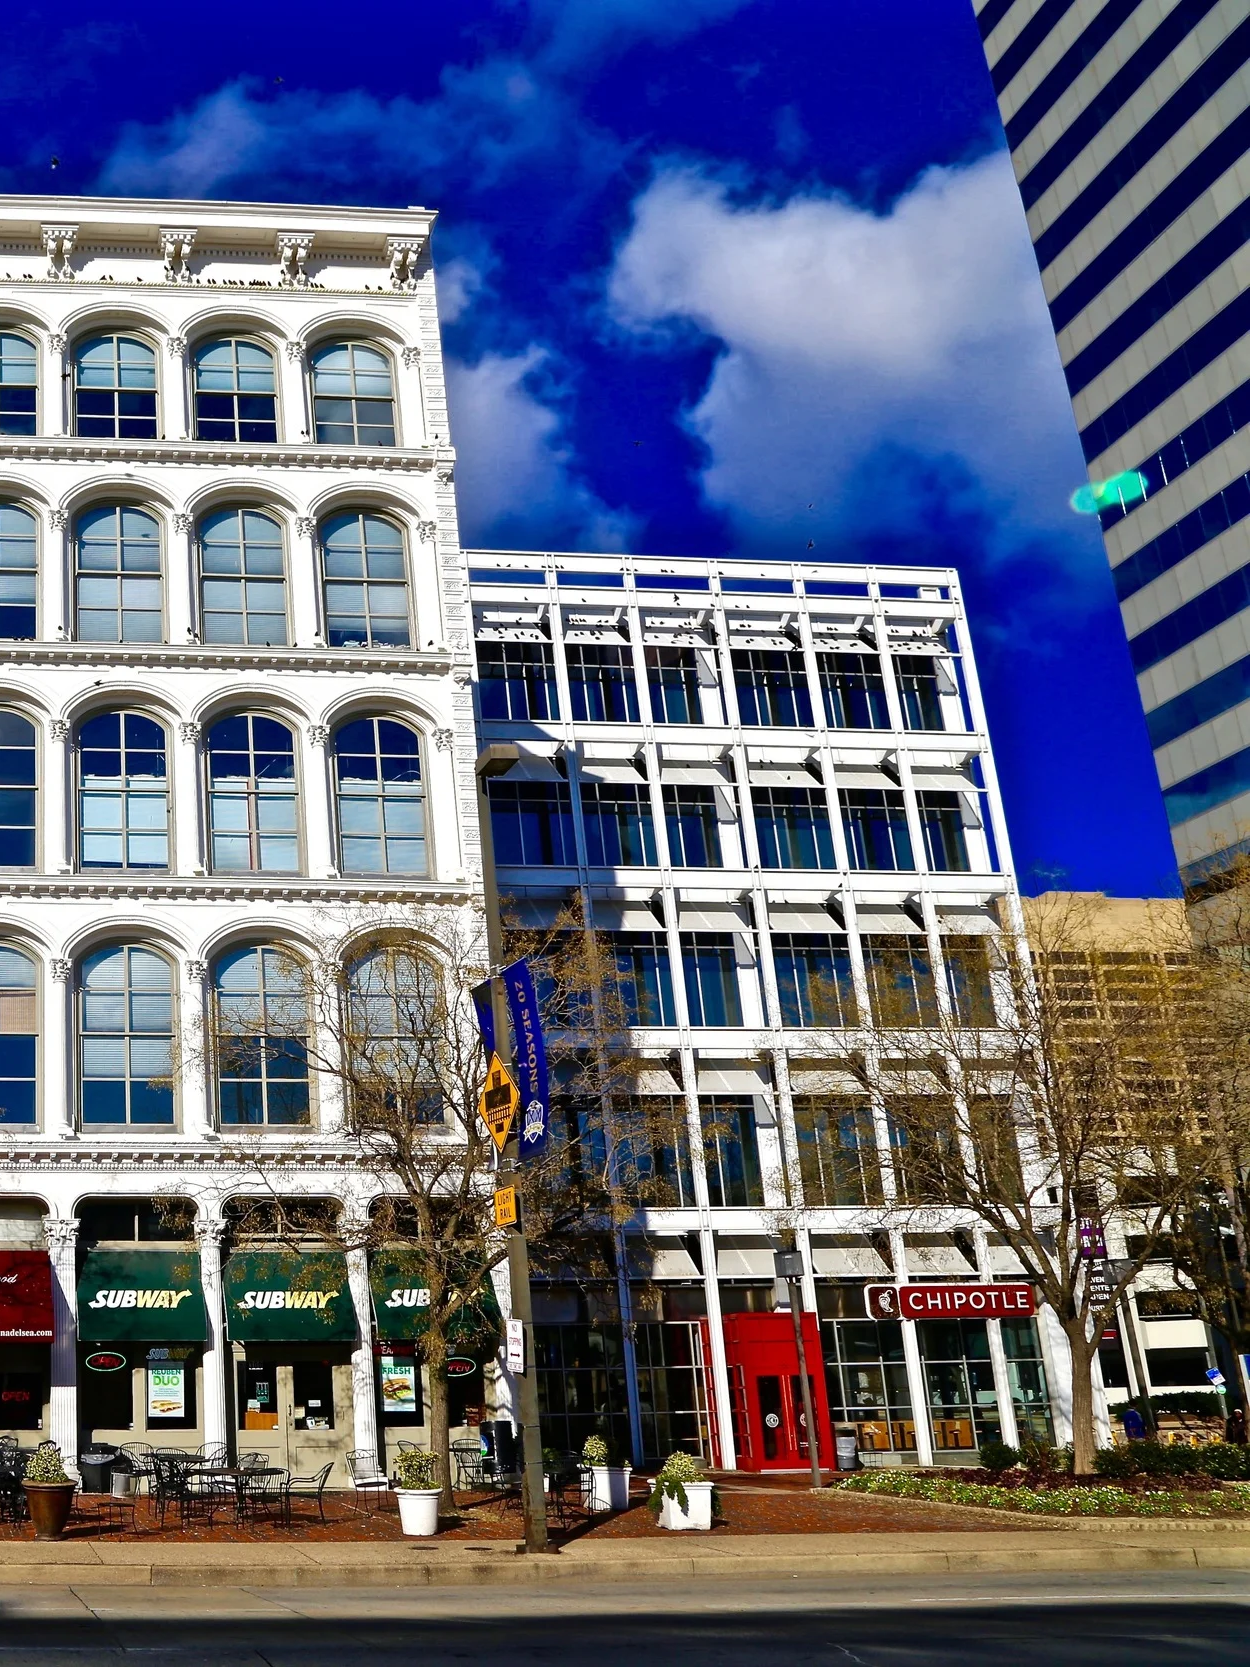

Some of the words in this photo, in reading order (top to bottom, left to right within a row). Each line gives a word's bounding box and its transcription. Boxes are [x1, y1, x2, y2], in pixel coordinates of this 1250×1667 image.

[514, 980, 526, 1003] 20
[521, 1008, 539, 1093] SEASONS
[498, 1191, 511, 1206] LIGHT
[499, 1206, 512, 1220] RAIL
[88, 1289, 193, 1309] SUBWAY
[237, 1290, 340, 1310] SUBWAY
[908, 1291, 1030, 1310] CHIPOTLE
[146, 1347, 195, 1360] SUBWAY
[382, 1367, 411, 1375] FRESH
[152, 1375, 180, 1386] DUO
[1, 1391, 30, 1402] OPEN
